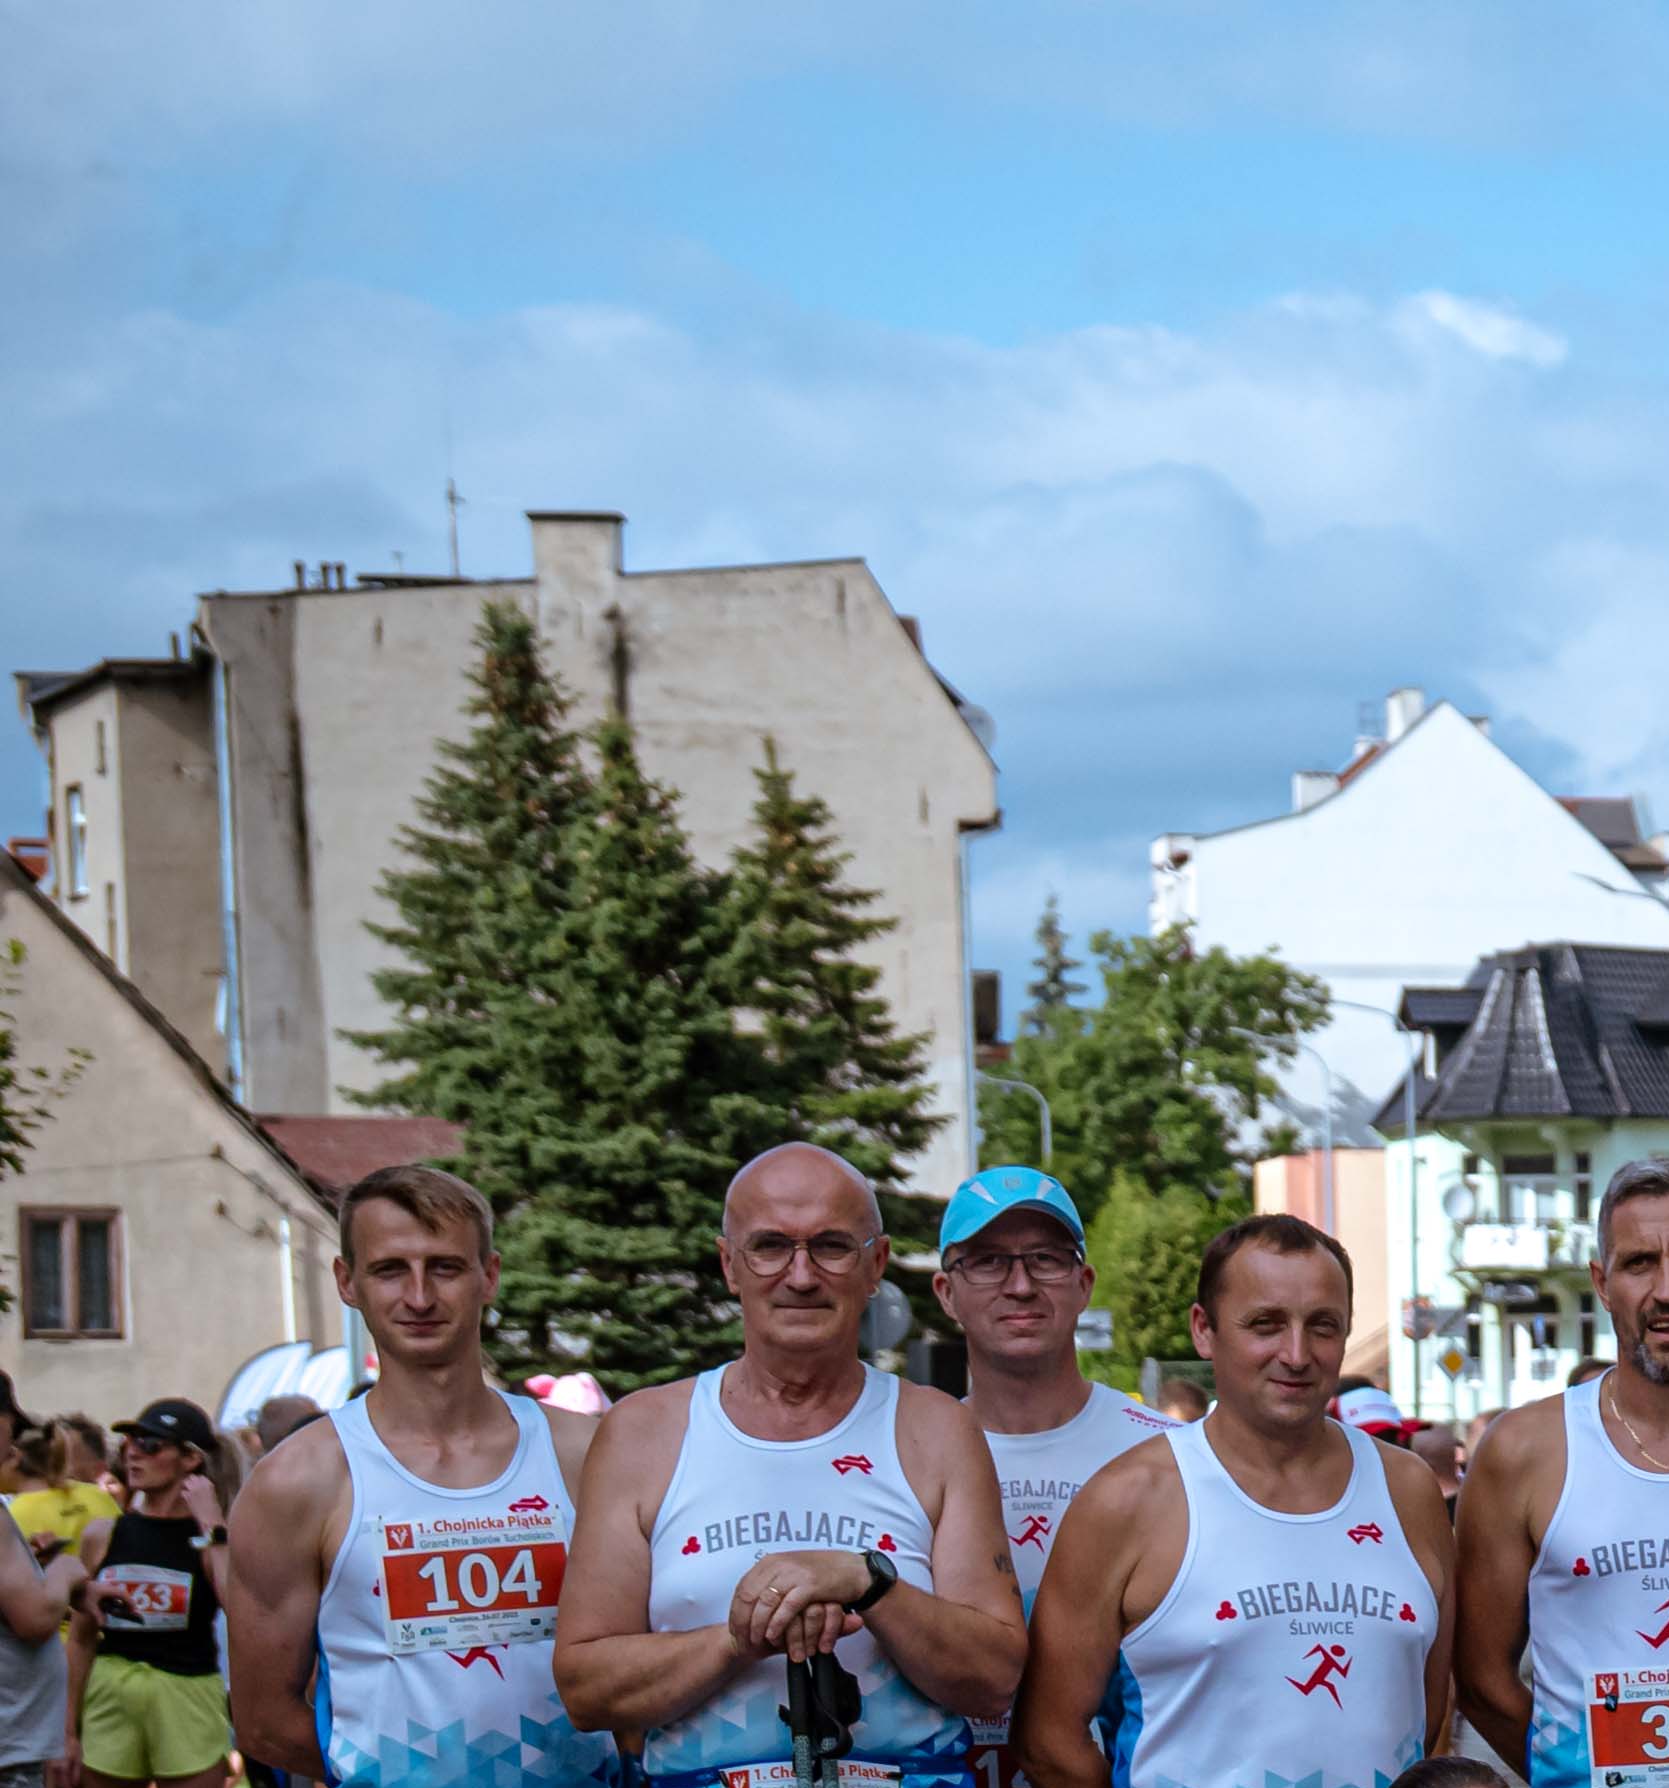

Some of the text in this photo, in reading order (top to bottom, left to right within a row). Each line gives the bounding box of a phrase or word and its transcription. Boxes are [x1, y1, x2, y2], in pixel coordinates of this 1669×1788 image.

[417, 1513, 552, 1534] 1. Chojnicka Piątka
[705, 1511, 875, 1554] BIEGAJĄCE
[418, 1549, 542, 1612] 104
[118, 1583, 172, 1611] 63
[1237, 1581, 1396, 1621] BIEGAJĄCE
[1290, 1619, 1354, 1635] ŚLIWICE
[1623, 1672, 1636, 1684] 1.
[1624, 1689, 1652, 1700] Grand
[754, 1769, 767, 1781] 1.
